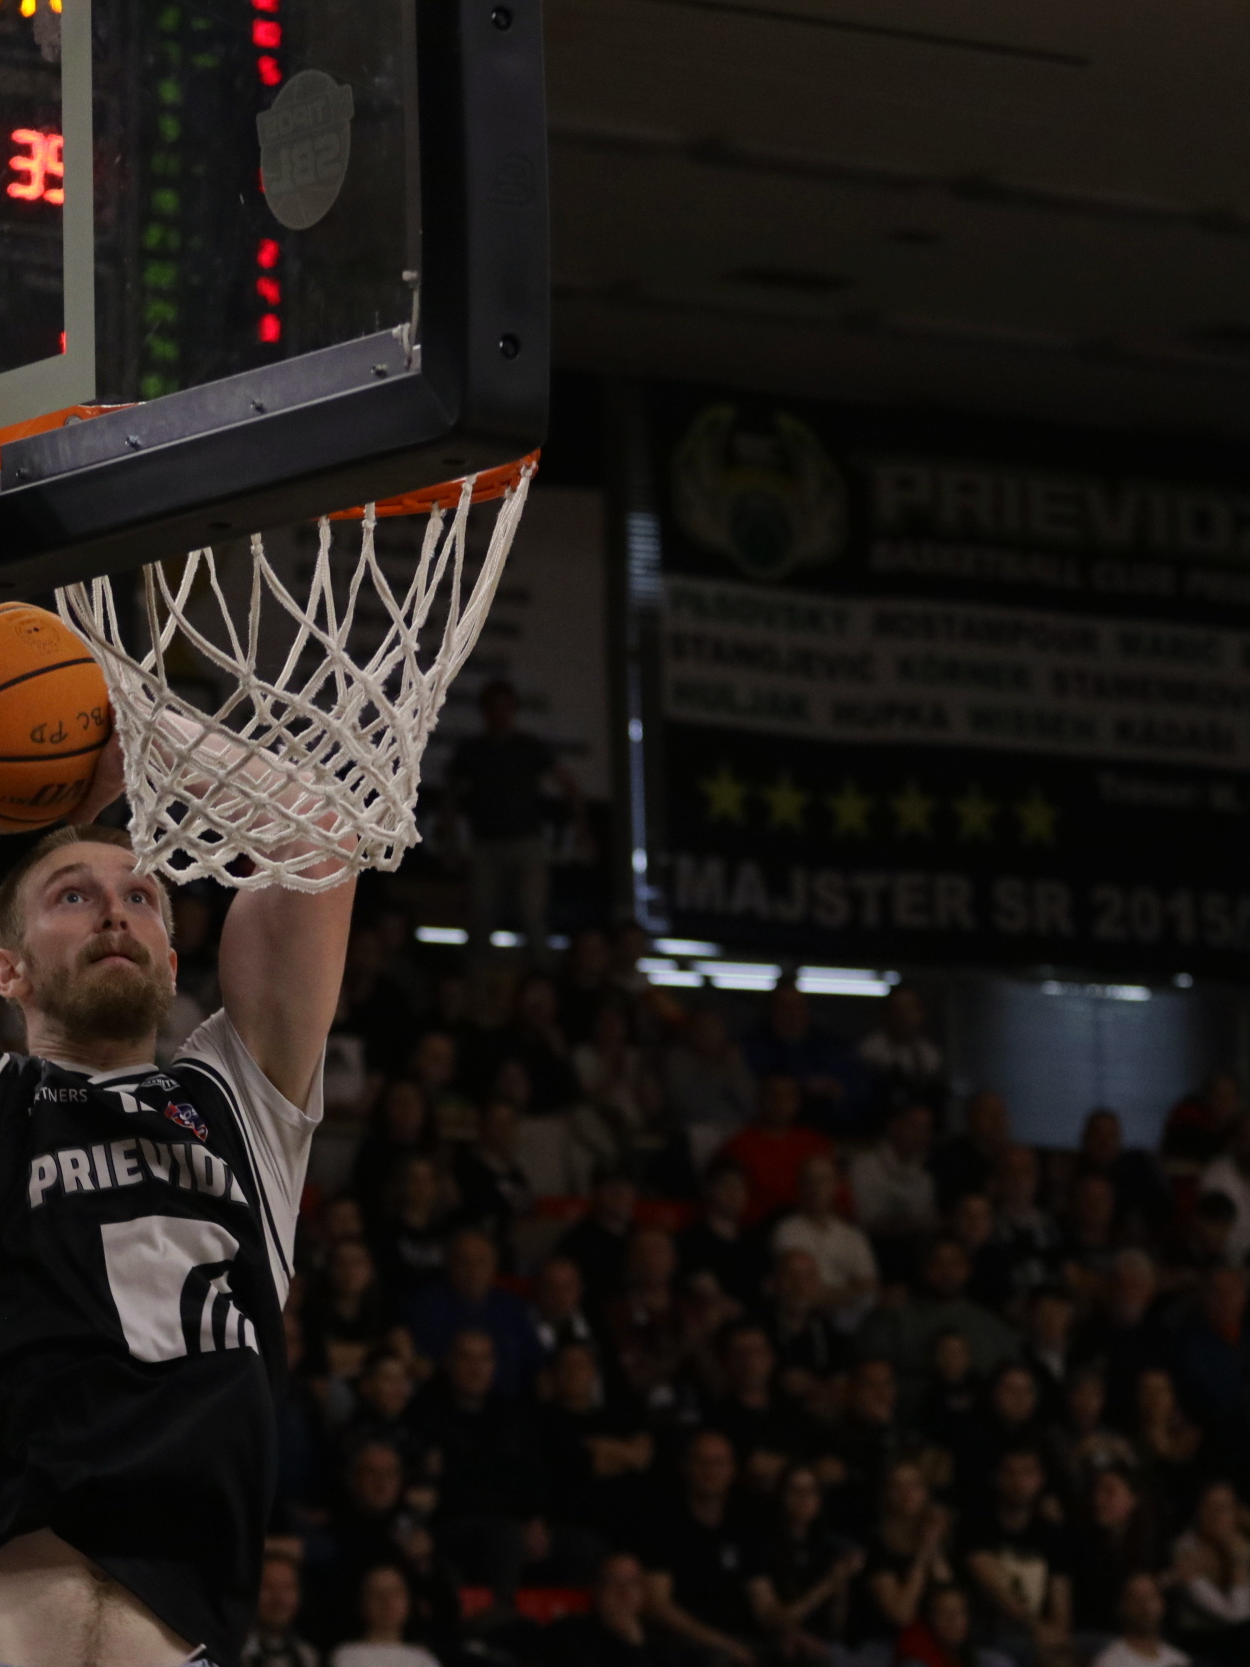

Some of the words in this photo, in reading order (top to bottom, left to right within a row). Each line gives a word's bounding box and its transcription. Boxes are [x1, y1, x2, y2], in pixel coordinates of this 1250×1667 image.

[29, 720, 70, 744] PD
[672, 850, 977, 934] MAJSTER
[990, 875, 1077, 941] SR
